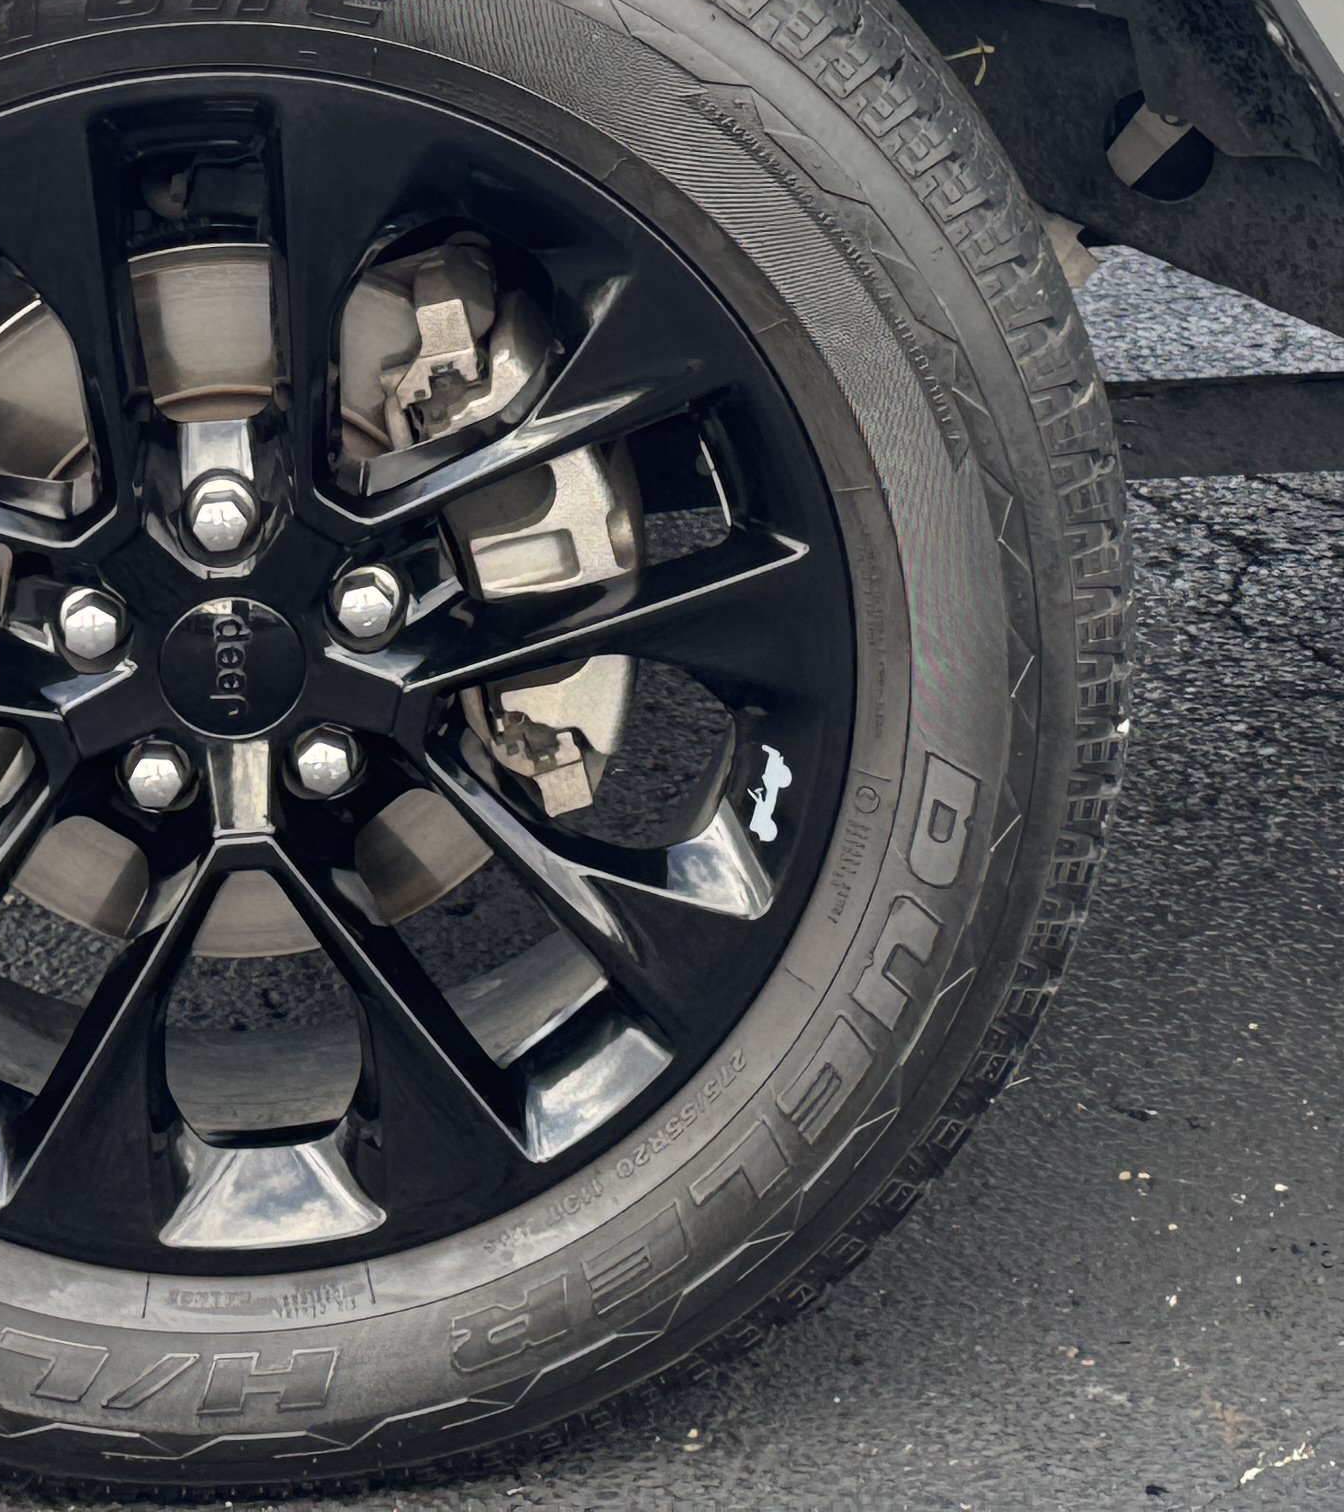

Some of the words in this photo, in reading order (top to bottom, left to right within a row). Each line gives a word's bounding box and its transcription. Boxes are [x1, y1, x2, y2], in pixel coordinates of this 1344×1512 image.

[209, 615, 253, 717] Jeep
[450, 749, 982, 1374] DUELER
[615, 1047, 747, 1180] 275/55R20
